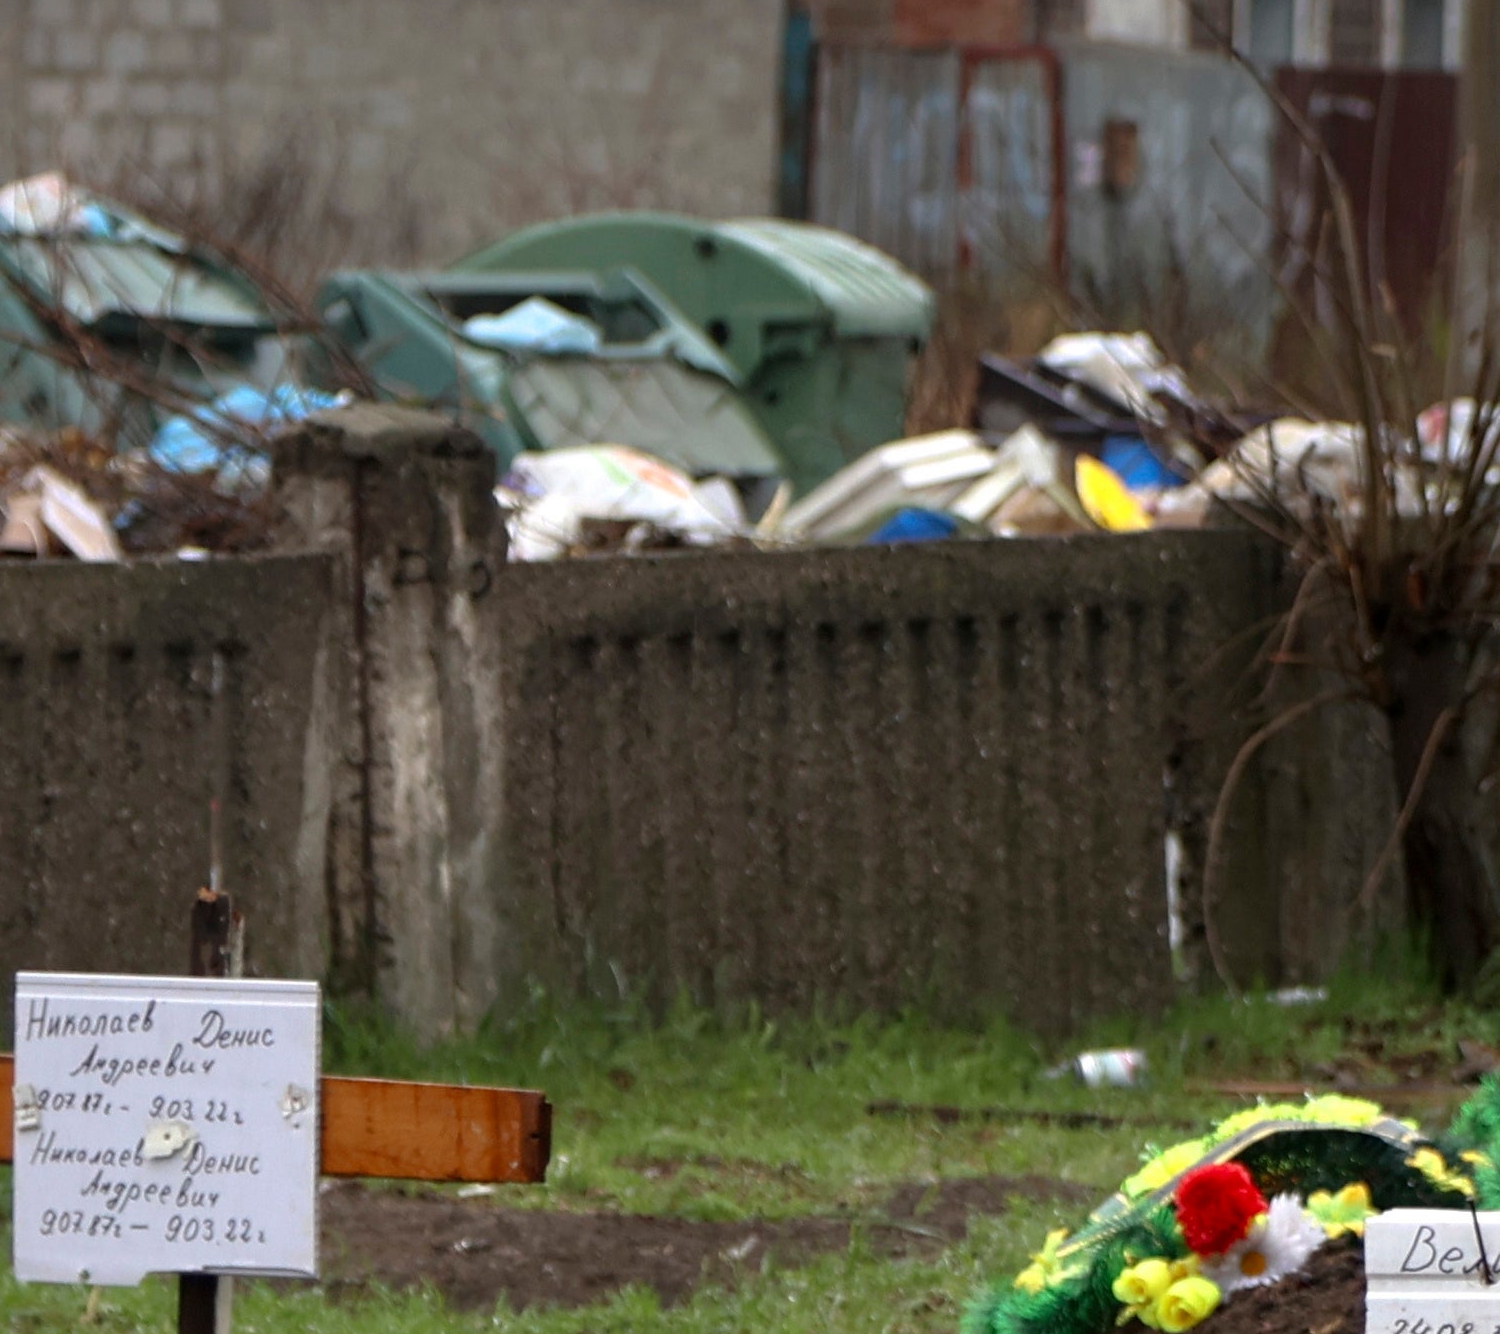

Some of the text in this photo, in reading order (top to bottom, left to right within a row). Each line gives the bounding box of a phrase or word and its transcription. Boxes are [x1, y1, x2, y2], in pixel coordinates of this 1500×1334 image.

[27, 998, 276, 1047] Николаев Денис
[70, 1043, 216, 1086] Андреевич
[31, 1131, 261, 1176] Николаев Денис
[81, 1169, 220, 1214] Андреевич
